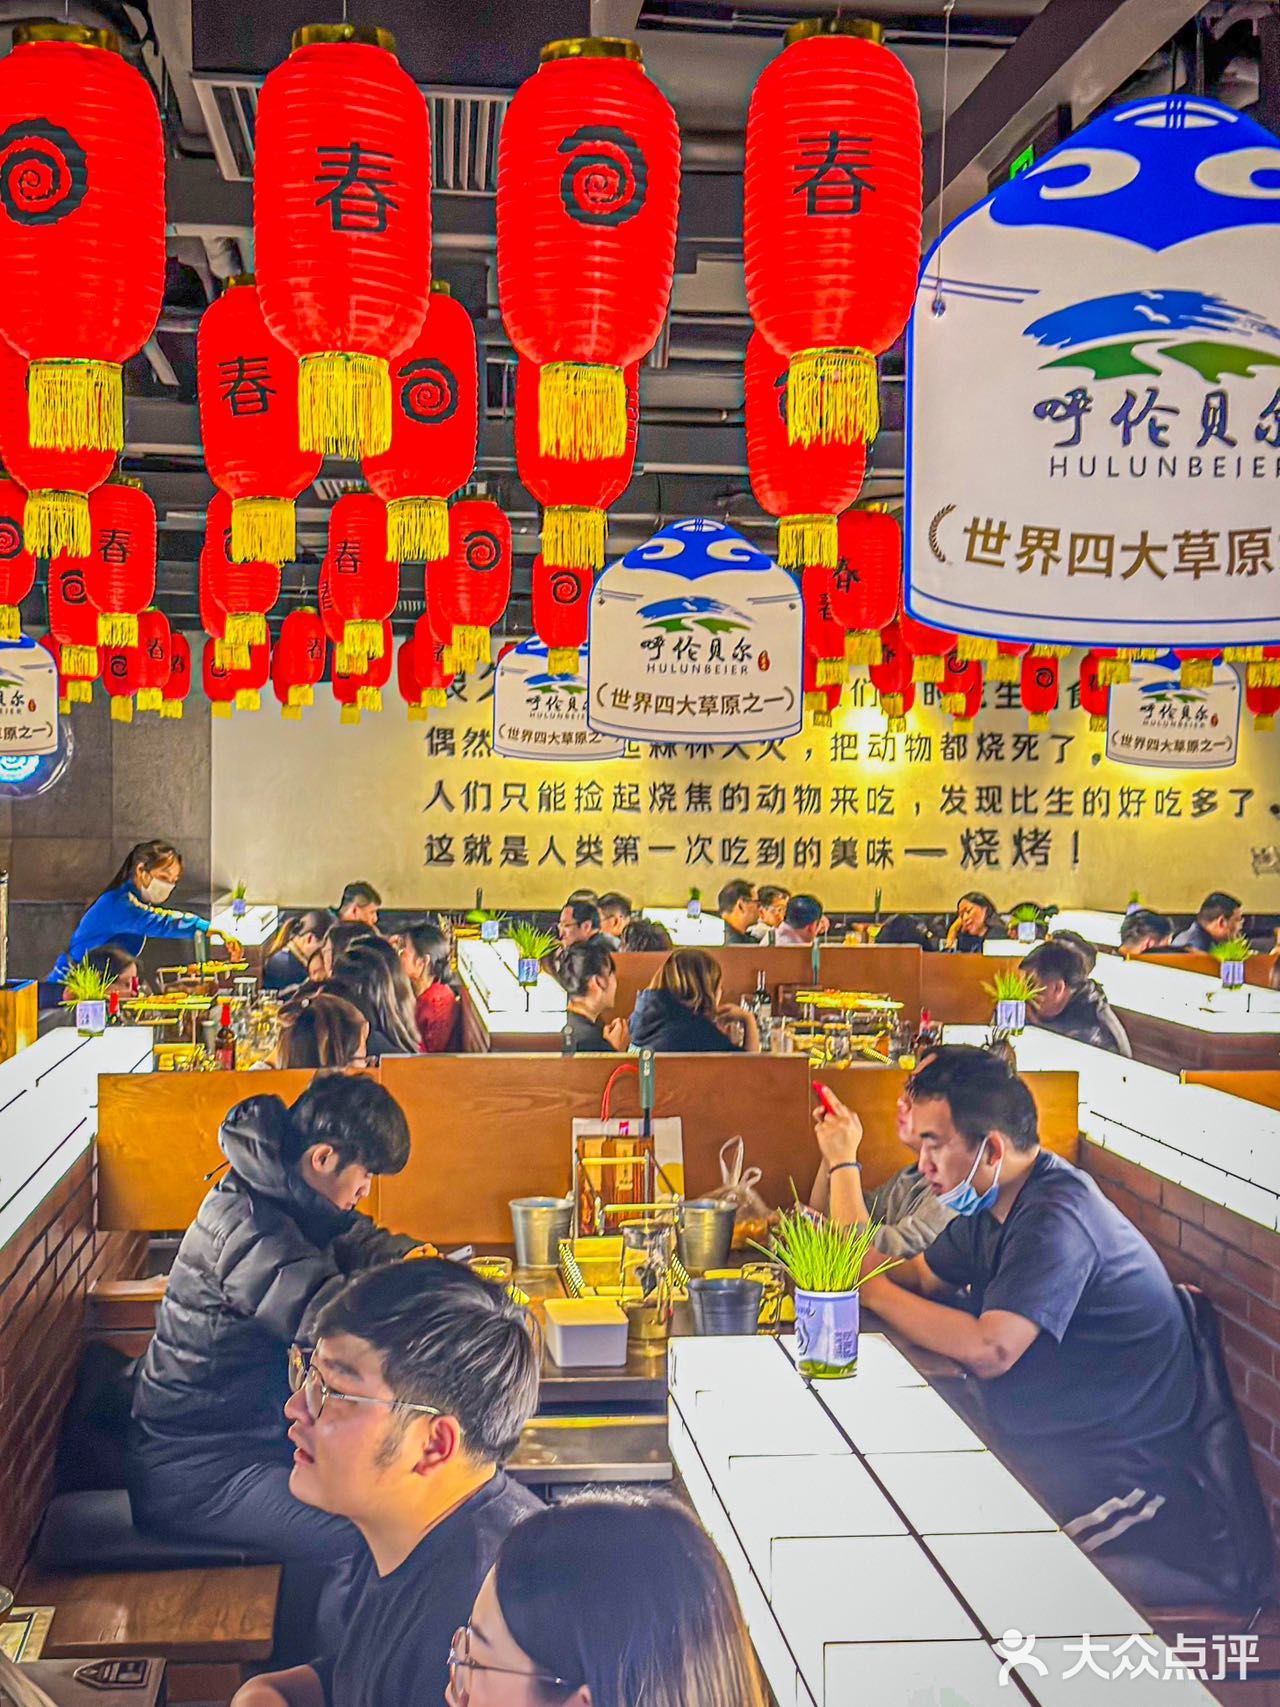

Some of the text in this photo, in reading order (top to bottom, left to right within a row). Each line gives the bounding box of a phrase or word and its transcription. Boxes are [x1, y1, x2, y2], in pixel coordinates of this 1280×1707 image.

[314, 142, 400, 234] 春
[793, 130, 876, 216] 春
[218, 356, 277, 417] 春
[1049, 455, 1280, 479] HULUNBEIE
[100, 529, 131, 563] 春
[334, 540, 363, 575] 春
[640, 636, 753, 663] 呼伦贝尔
[646, 663, 748, 675] HULUNBEIER
[526, 695, 588, 711] 呼伦贝
